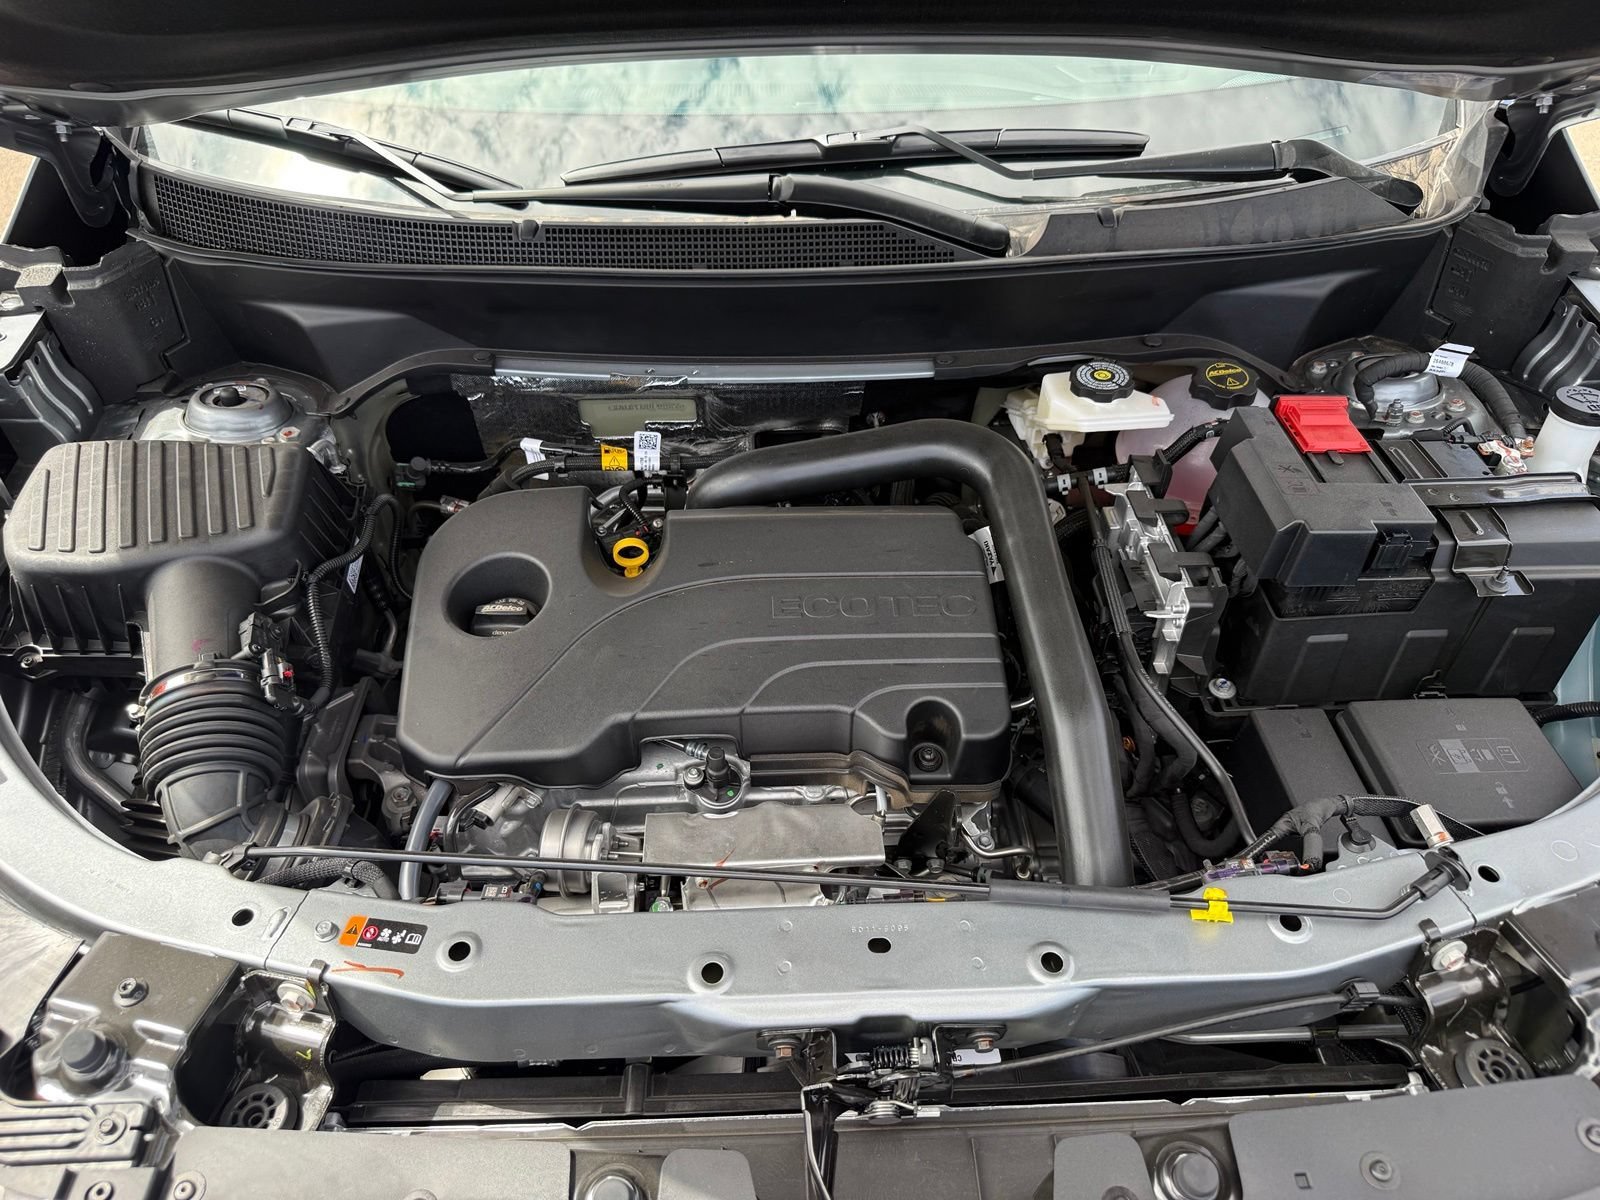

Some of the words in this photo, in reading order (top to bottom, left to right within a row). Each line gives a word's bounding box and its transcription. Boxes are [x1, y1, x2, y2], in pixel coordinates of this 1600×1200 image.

[983, 540, 995, 566] YAZAKI
[481, 604, 523, 612] ACDelco
[771, 594, 977, 618] ECOTEC
[501, 886, 508, 894] B
